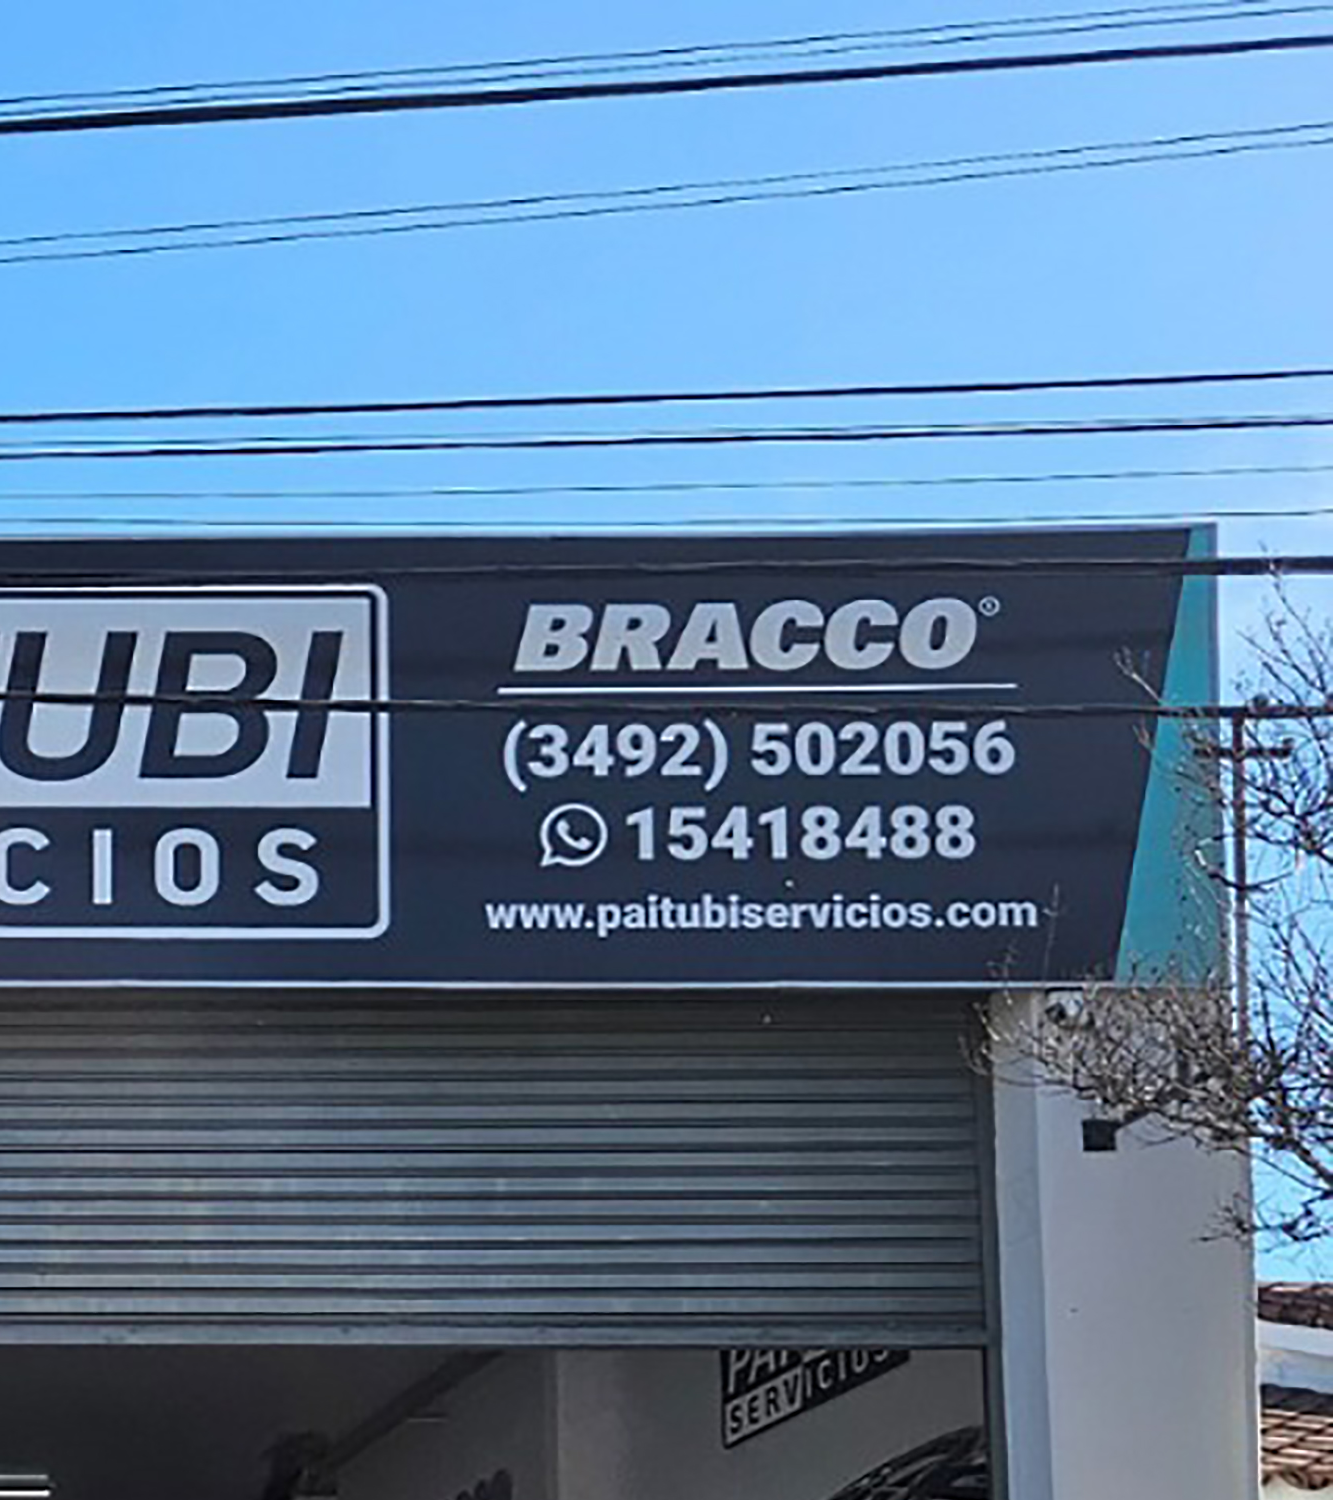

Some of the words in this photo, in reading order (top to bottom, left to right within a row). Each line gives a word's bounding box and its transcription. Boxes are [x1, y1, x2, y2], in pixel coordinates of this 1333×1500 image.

[502, 718, 729, 793] (3492)
[750, 718, 1017, 778] 502056
[625, 805, 977, 861] 15418488
[485, 894, 1038, 937] www.paitubiservicios.com
